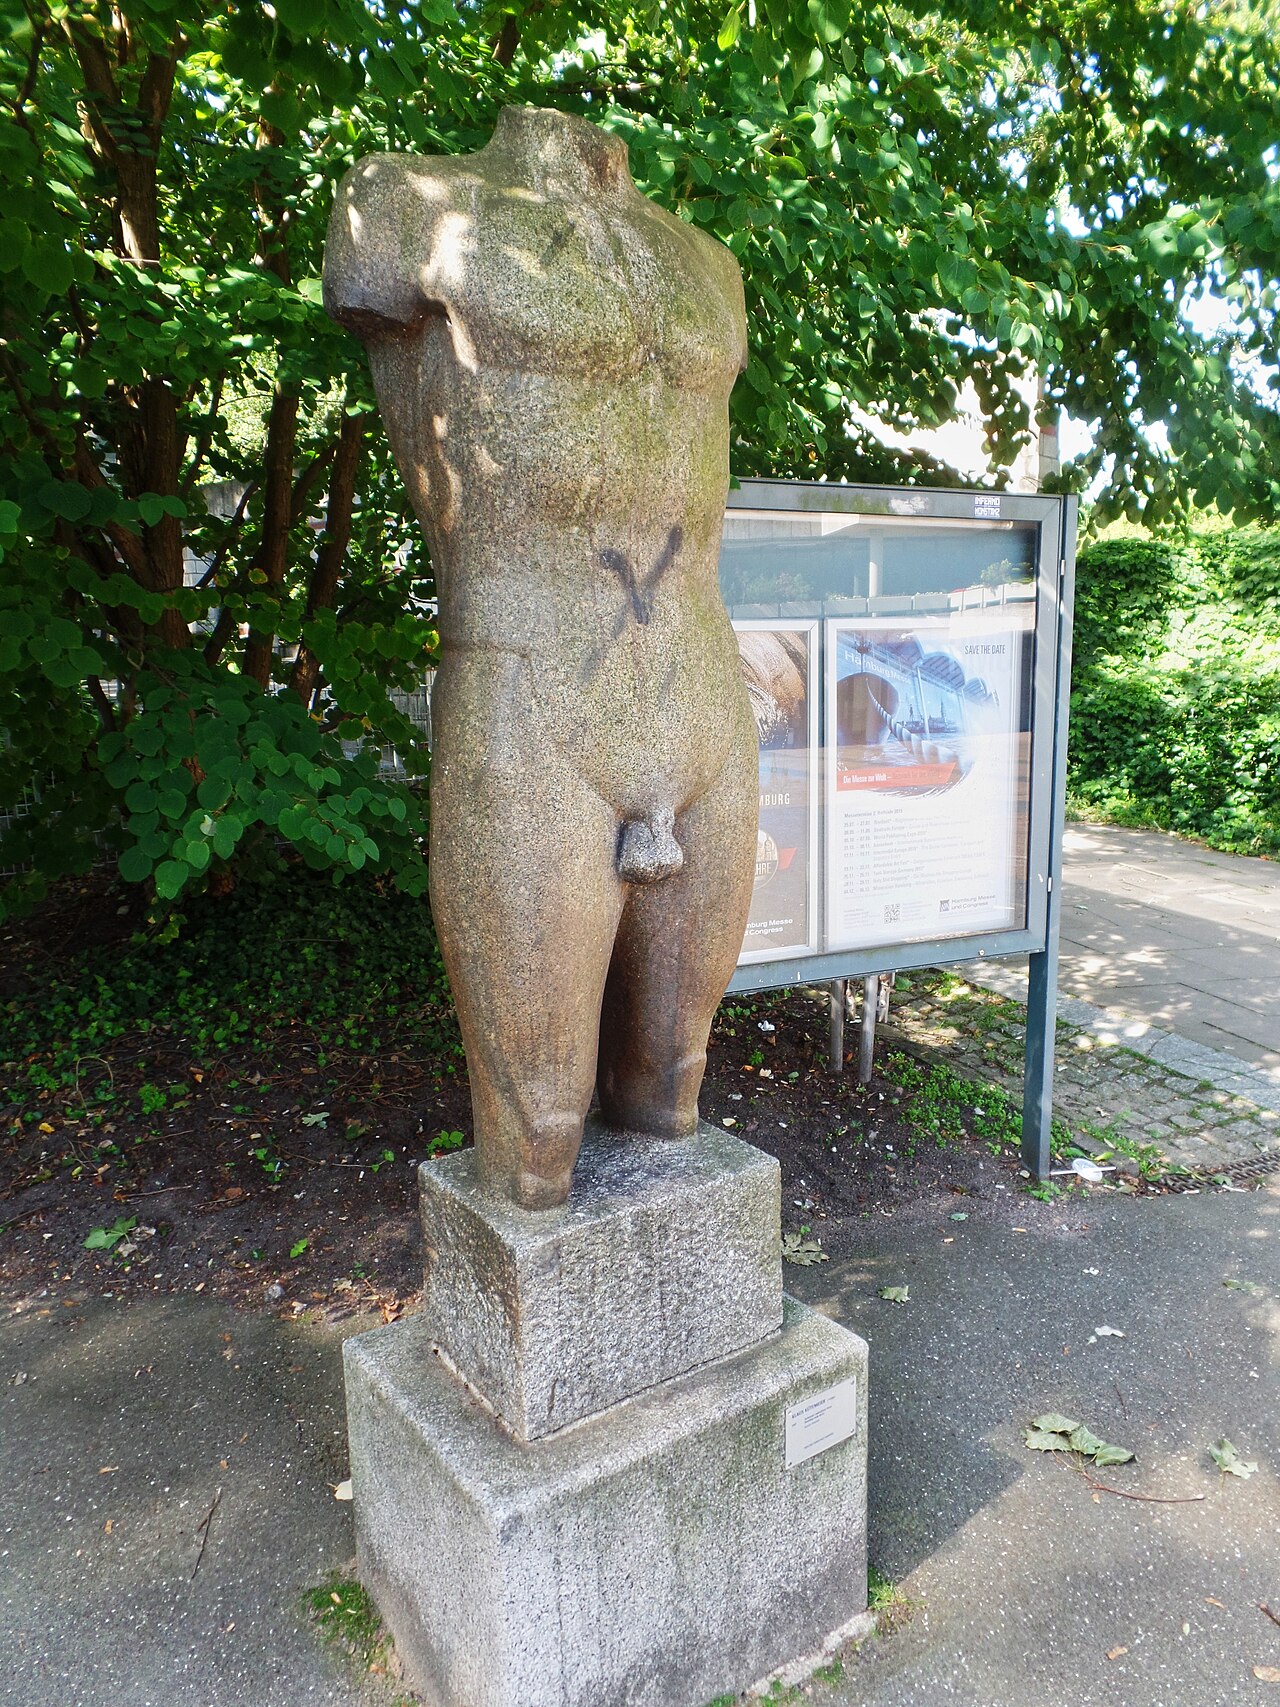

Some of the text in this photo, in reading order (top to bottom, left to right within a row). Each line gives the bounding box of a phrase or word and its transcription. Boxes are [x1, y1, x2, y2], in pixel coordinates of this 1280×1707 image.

[964, 644, 1006, 655] SAVE THE DATE
[844, 650, 892, 678] Hamburg
[843, 775, 852, 784] Die
[852, 774, 868, 783] Messe
[875, 773, 887, 782] Welt
[759, 793, 790, 806] MBURG
[755, 862, 772, 875] HRE
[963, 901, 989, 909] Congress
[746, 918, 793, 930] mburg Messe
[749, 927, 784, 937] Congress
